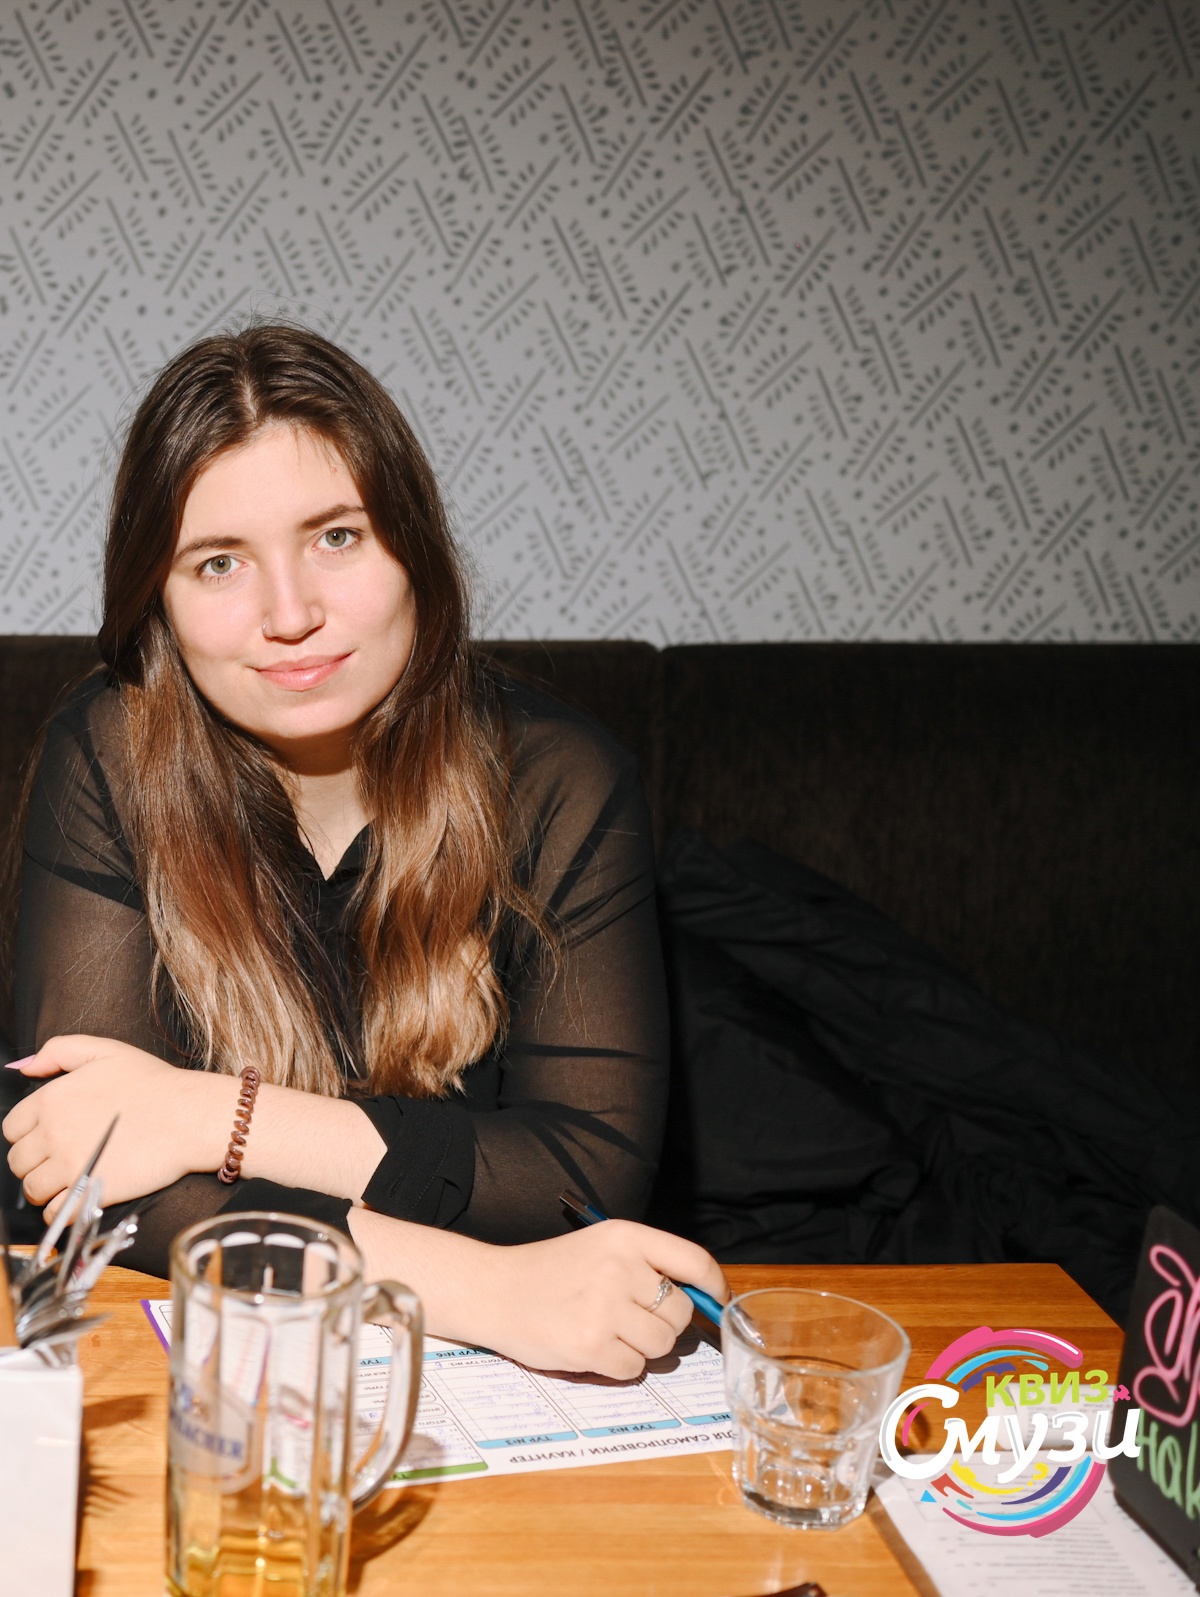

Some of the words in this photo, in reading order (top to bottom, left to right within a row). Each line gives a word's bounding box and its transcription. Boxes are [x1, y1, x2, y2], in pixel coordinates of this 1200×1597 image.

[608, 1426, 630, 1434] №2
[632, 1423, 656, 1433] ТУР
[505, 1438, 527, 1446] №3
[528, 1436, 552, 1445] ТУР
[588, 1432, 711, 1455] САМОПРОВЕРКИ
[509, 1450, 576, 1464] КАУНТЕР
